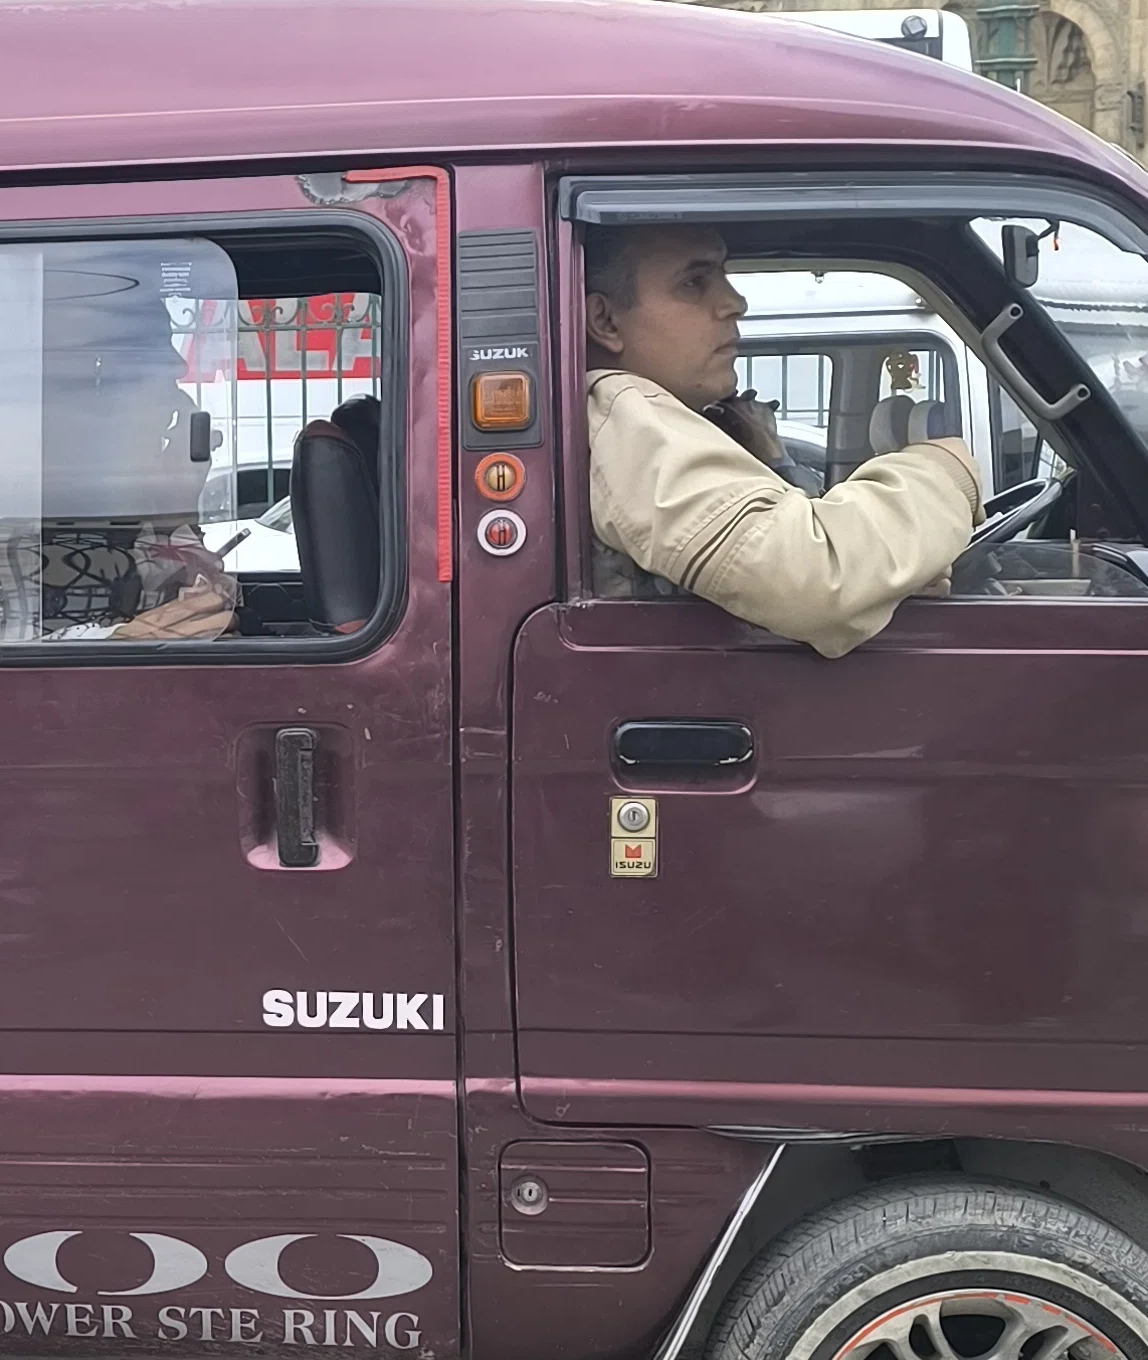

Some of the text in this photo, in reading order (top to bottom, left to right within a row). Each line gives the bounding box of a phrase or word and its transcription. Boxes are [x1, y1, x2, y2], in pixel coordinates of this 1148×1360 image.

[469, 347, 532, 361] SUZUK
[615, 861, 652, 869] ISUZU
[262, 989, 445, 1031] SUZUKI
